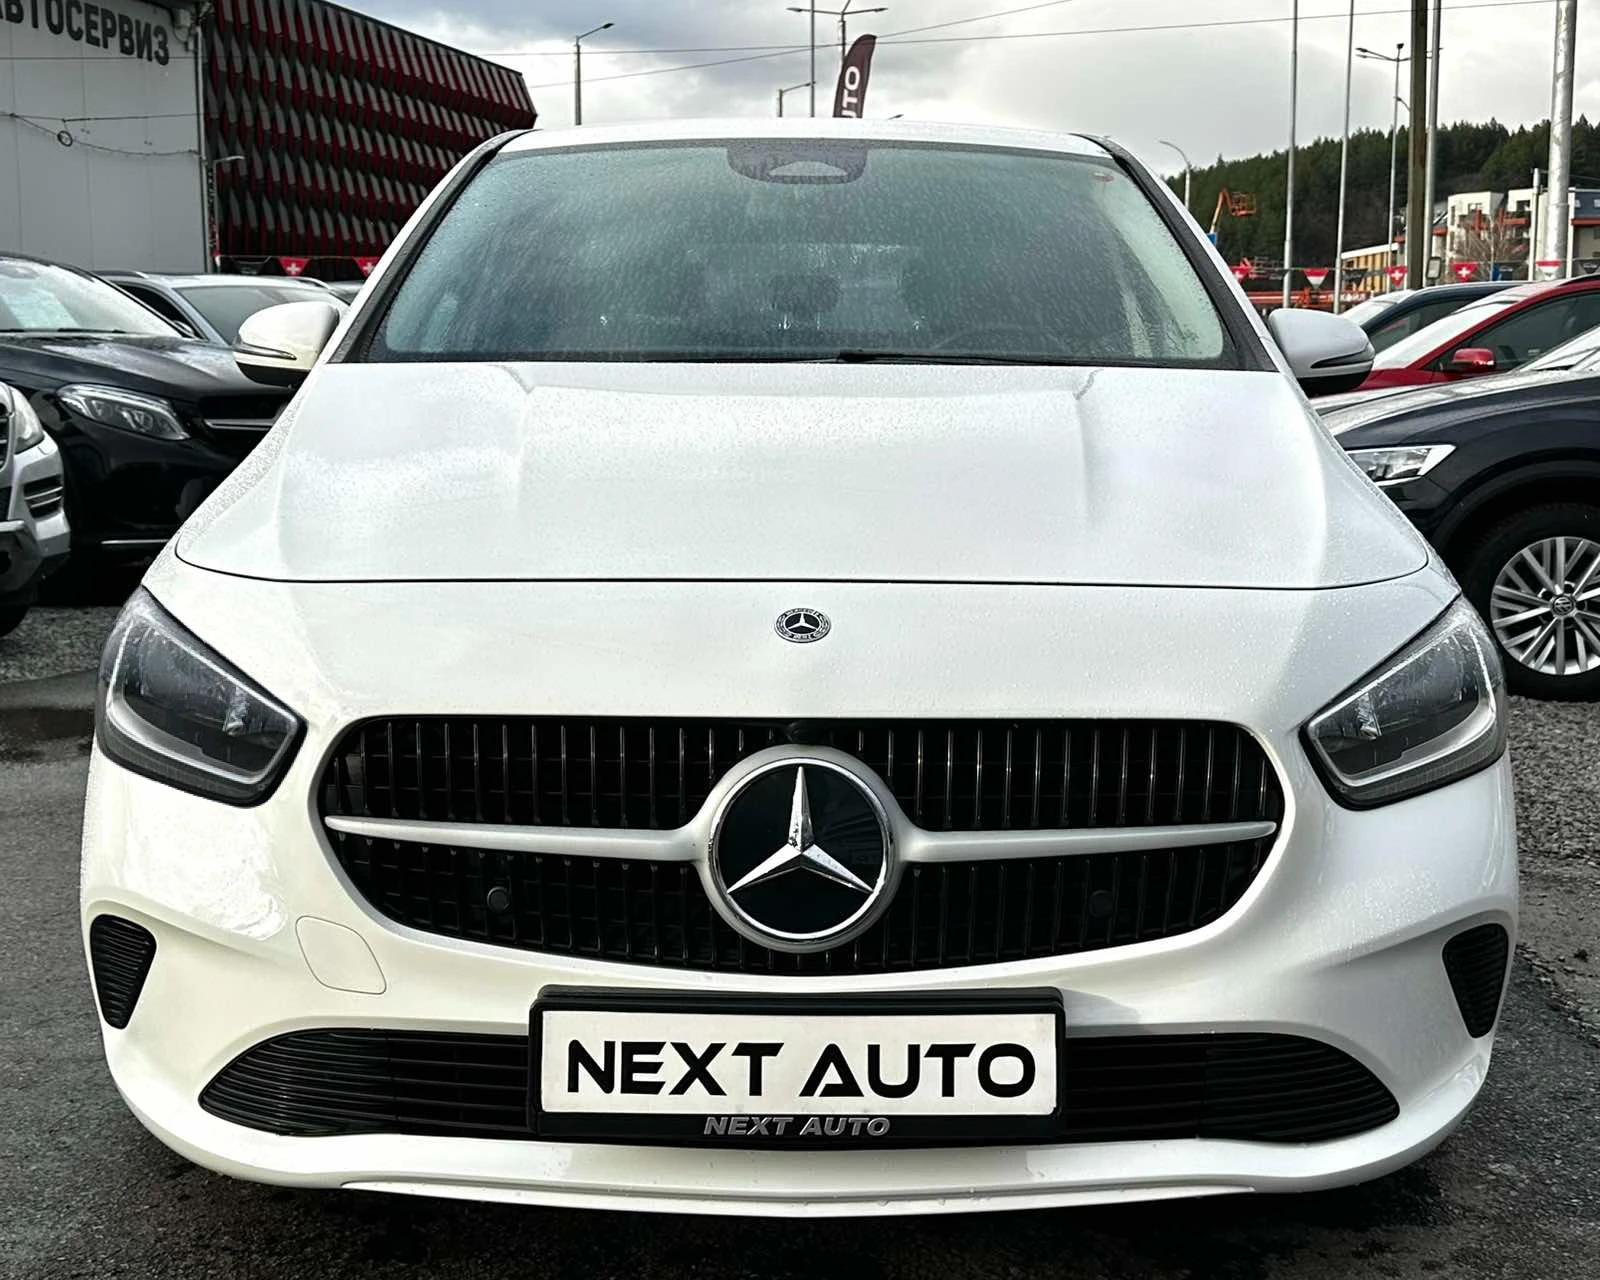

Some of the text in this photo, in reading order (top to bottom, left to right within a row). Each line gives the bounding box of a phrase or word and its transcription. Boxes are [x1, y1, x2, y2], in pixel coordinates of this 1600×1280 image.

[0, 0, 169, 65] ВТОСЕРВИЗ
[568, 1039, 1036, 1098] NEXT AUTO
[703, 1116, 890, 1136] NEXT AUTO
